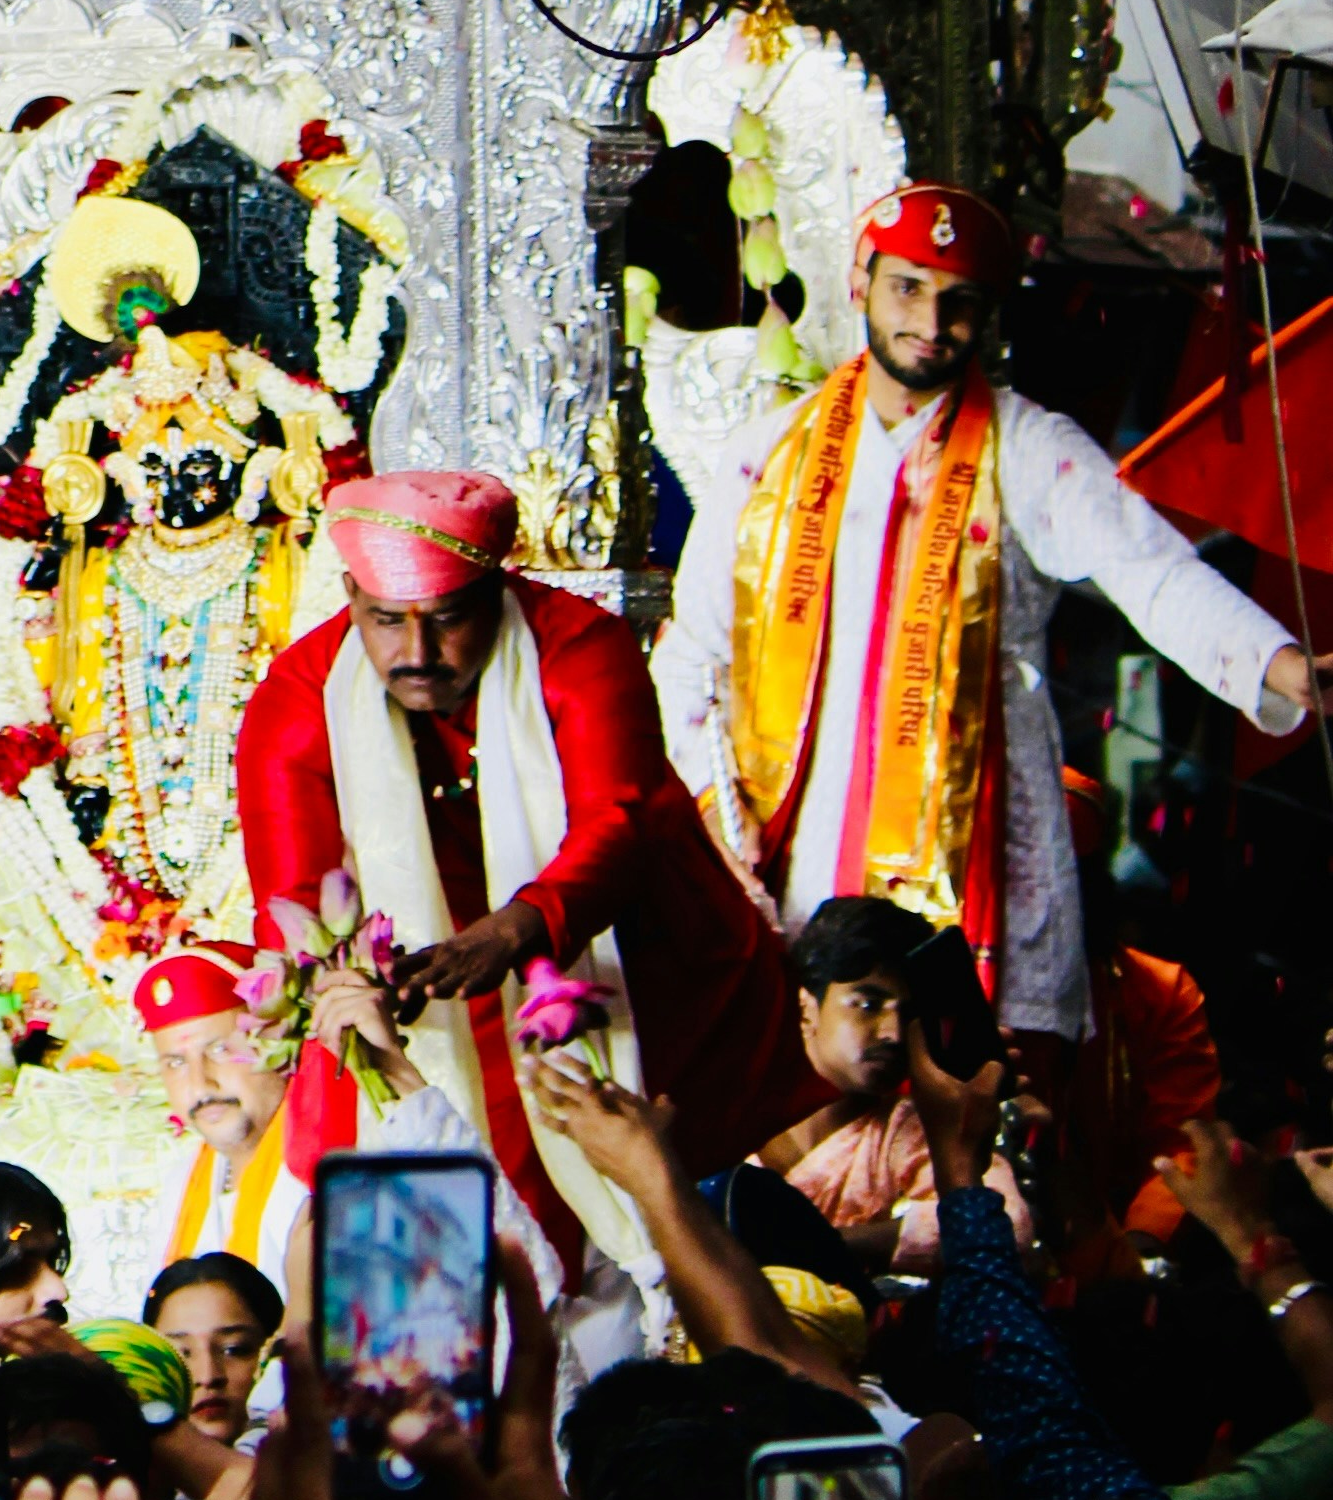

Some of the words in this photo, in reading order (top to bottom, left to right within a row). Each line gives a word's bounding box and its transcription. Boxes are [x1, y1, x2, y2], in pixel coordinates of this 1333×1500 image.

[928, 489, 961, 556] जगदीश
[901, 618, 931, 683] पुजारी
[896, 686, 927, 747] परिषद
